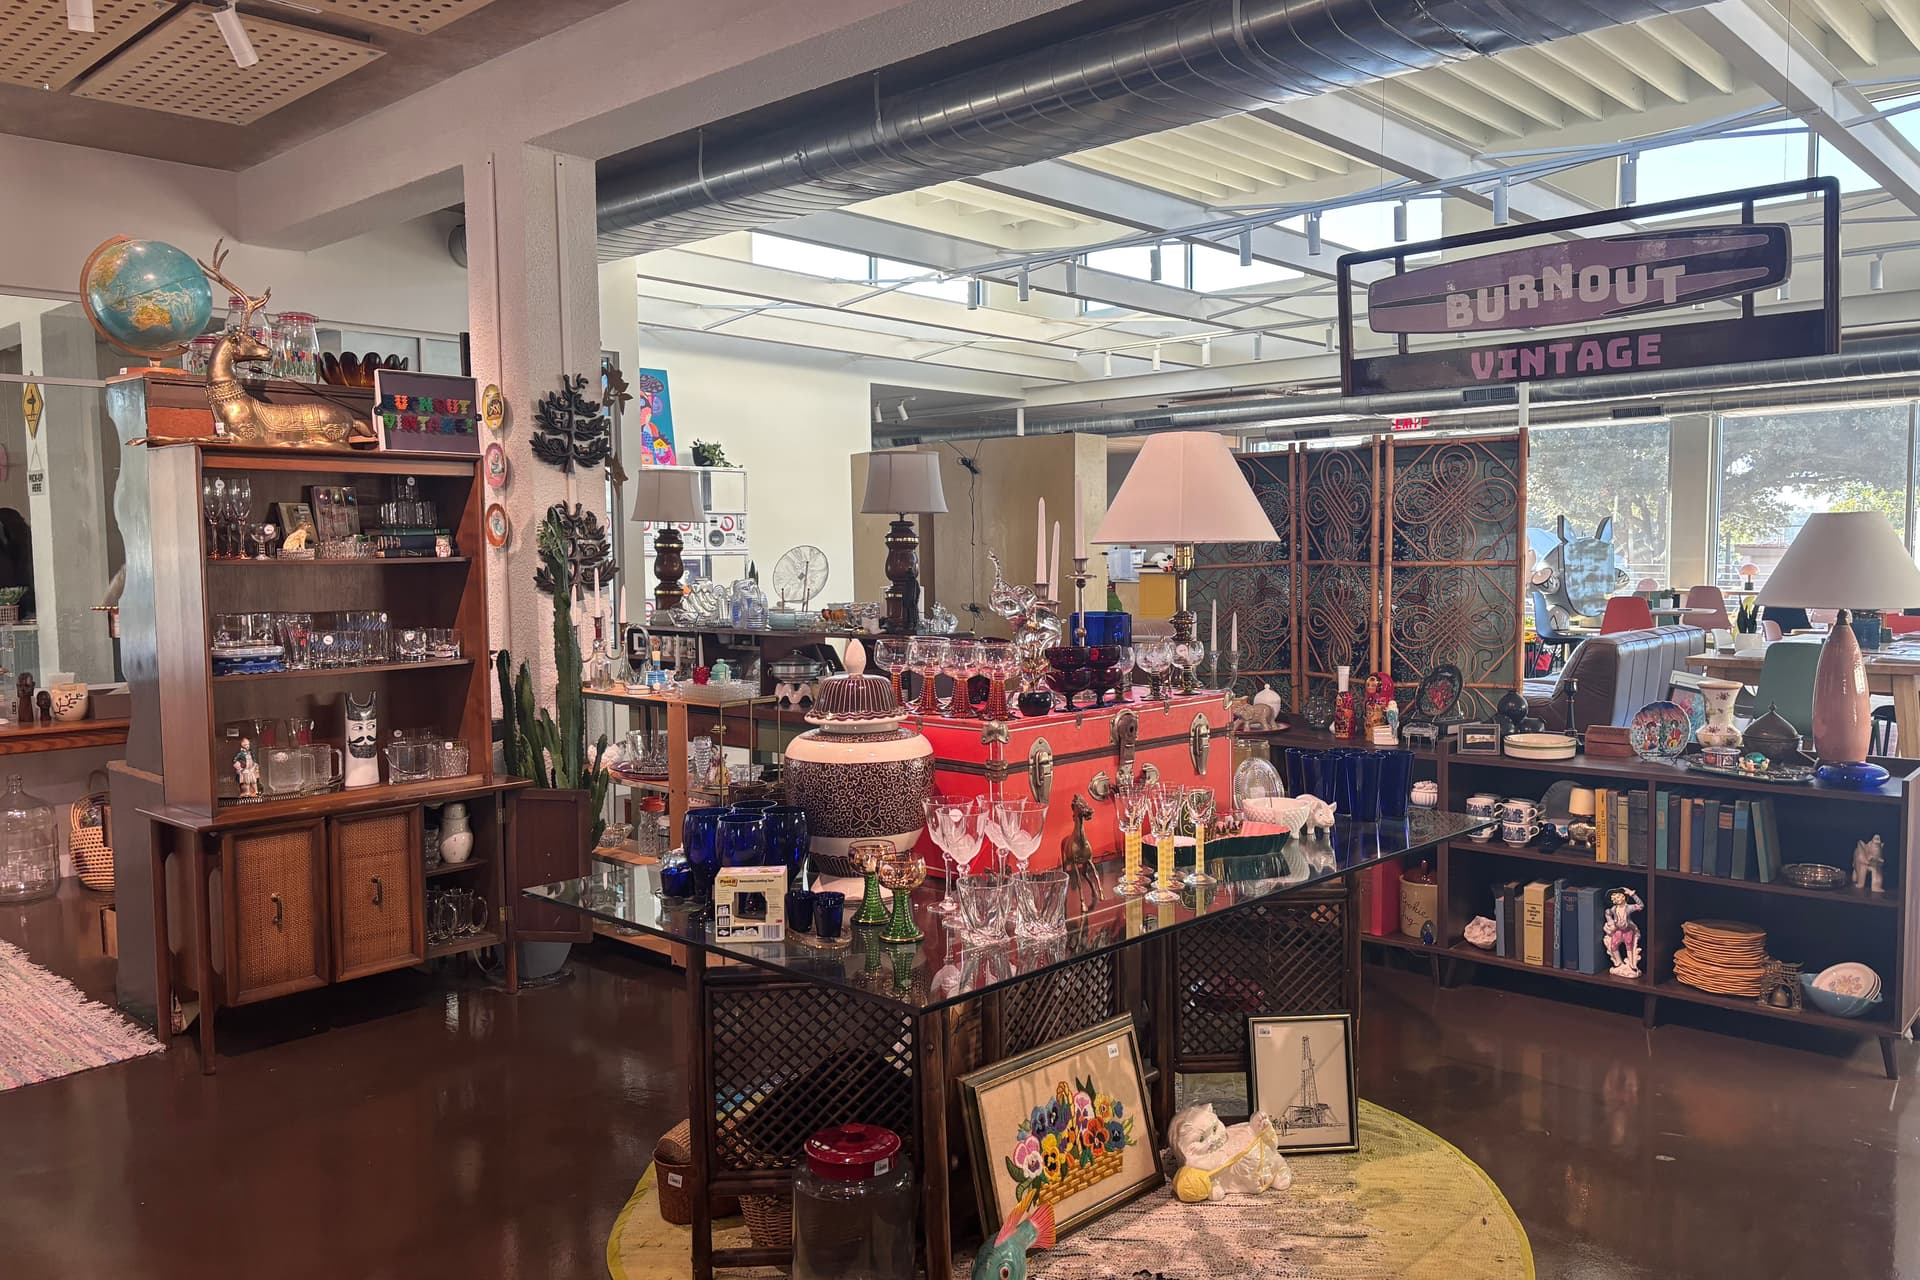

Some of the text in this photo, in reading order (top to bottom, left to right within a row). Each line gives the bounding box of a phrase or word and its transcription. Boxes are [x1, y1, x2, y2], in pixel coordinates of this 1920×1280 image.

[1446, 263, 1686, 328] BURNOUT
[1471, 334, 1661, 380] VINTAGE
[382, 394, 472, 415] BURNOUT
